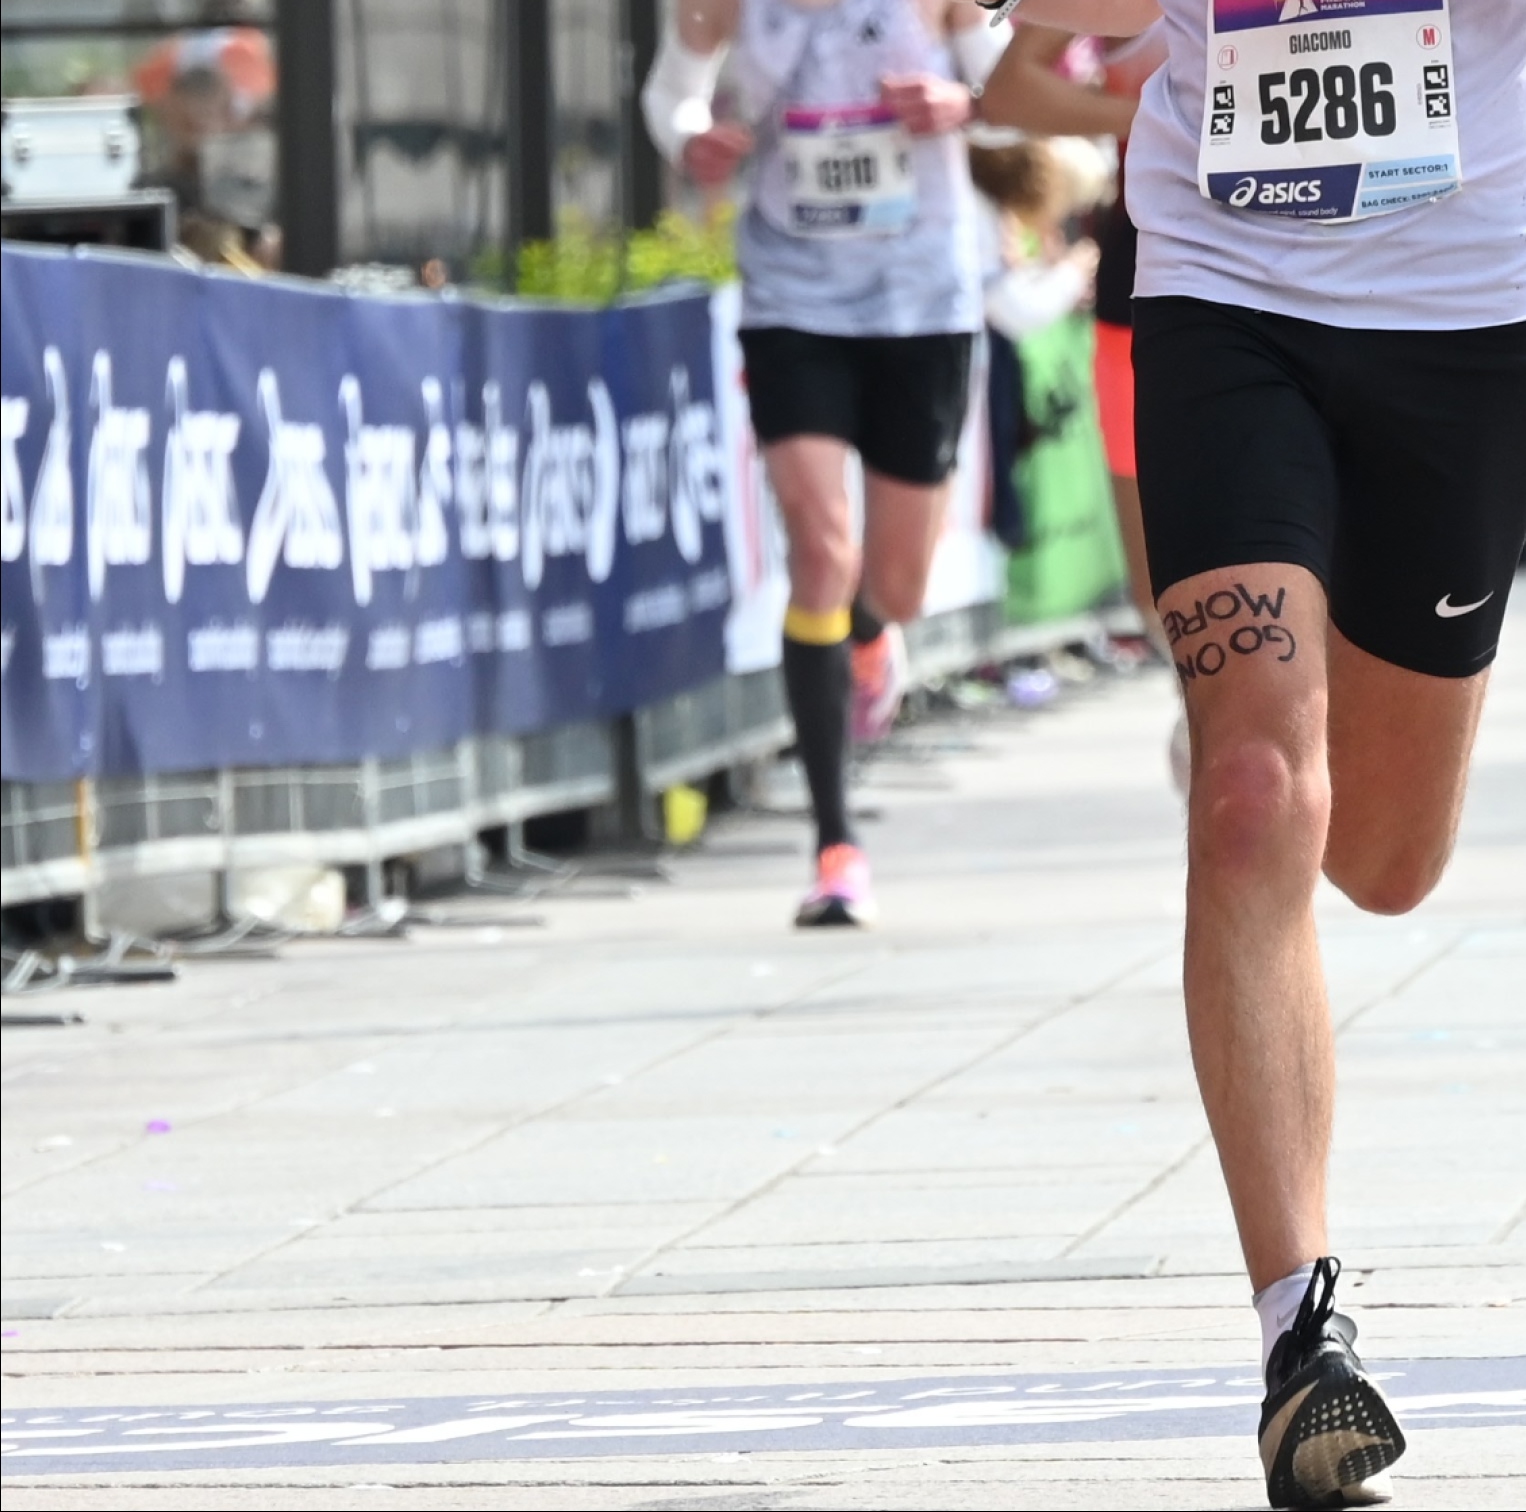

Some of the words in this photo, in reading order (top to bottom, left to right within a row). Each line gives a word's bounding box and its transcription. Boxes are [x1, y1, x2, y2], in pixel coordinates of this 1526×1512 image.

[1320, 1, 1366, 11] MARATHON
[1289, 29, 1352, 55] GIACOMO
[1422, 27, 1436, 46] M
[1258, 61, 1397, 146] 5286
[1368, 168, 1399, 180] START
[1402, 163, 1448, 176] SECTOR:1
[1258, 179, 1322, 204] asics
[1361, 199, 1379, 209] BAG
[1320, 206, 1338, 216] body
[1163, 583, 1286, 646] MORE
[1229, 624, 1297, 662] GO
[1176, 642, 1226, 685] ON
